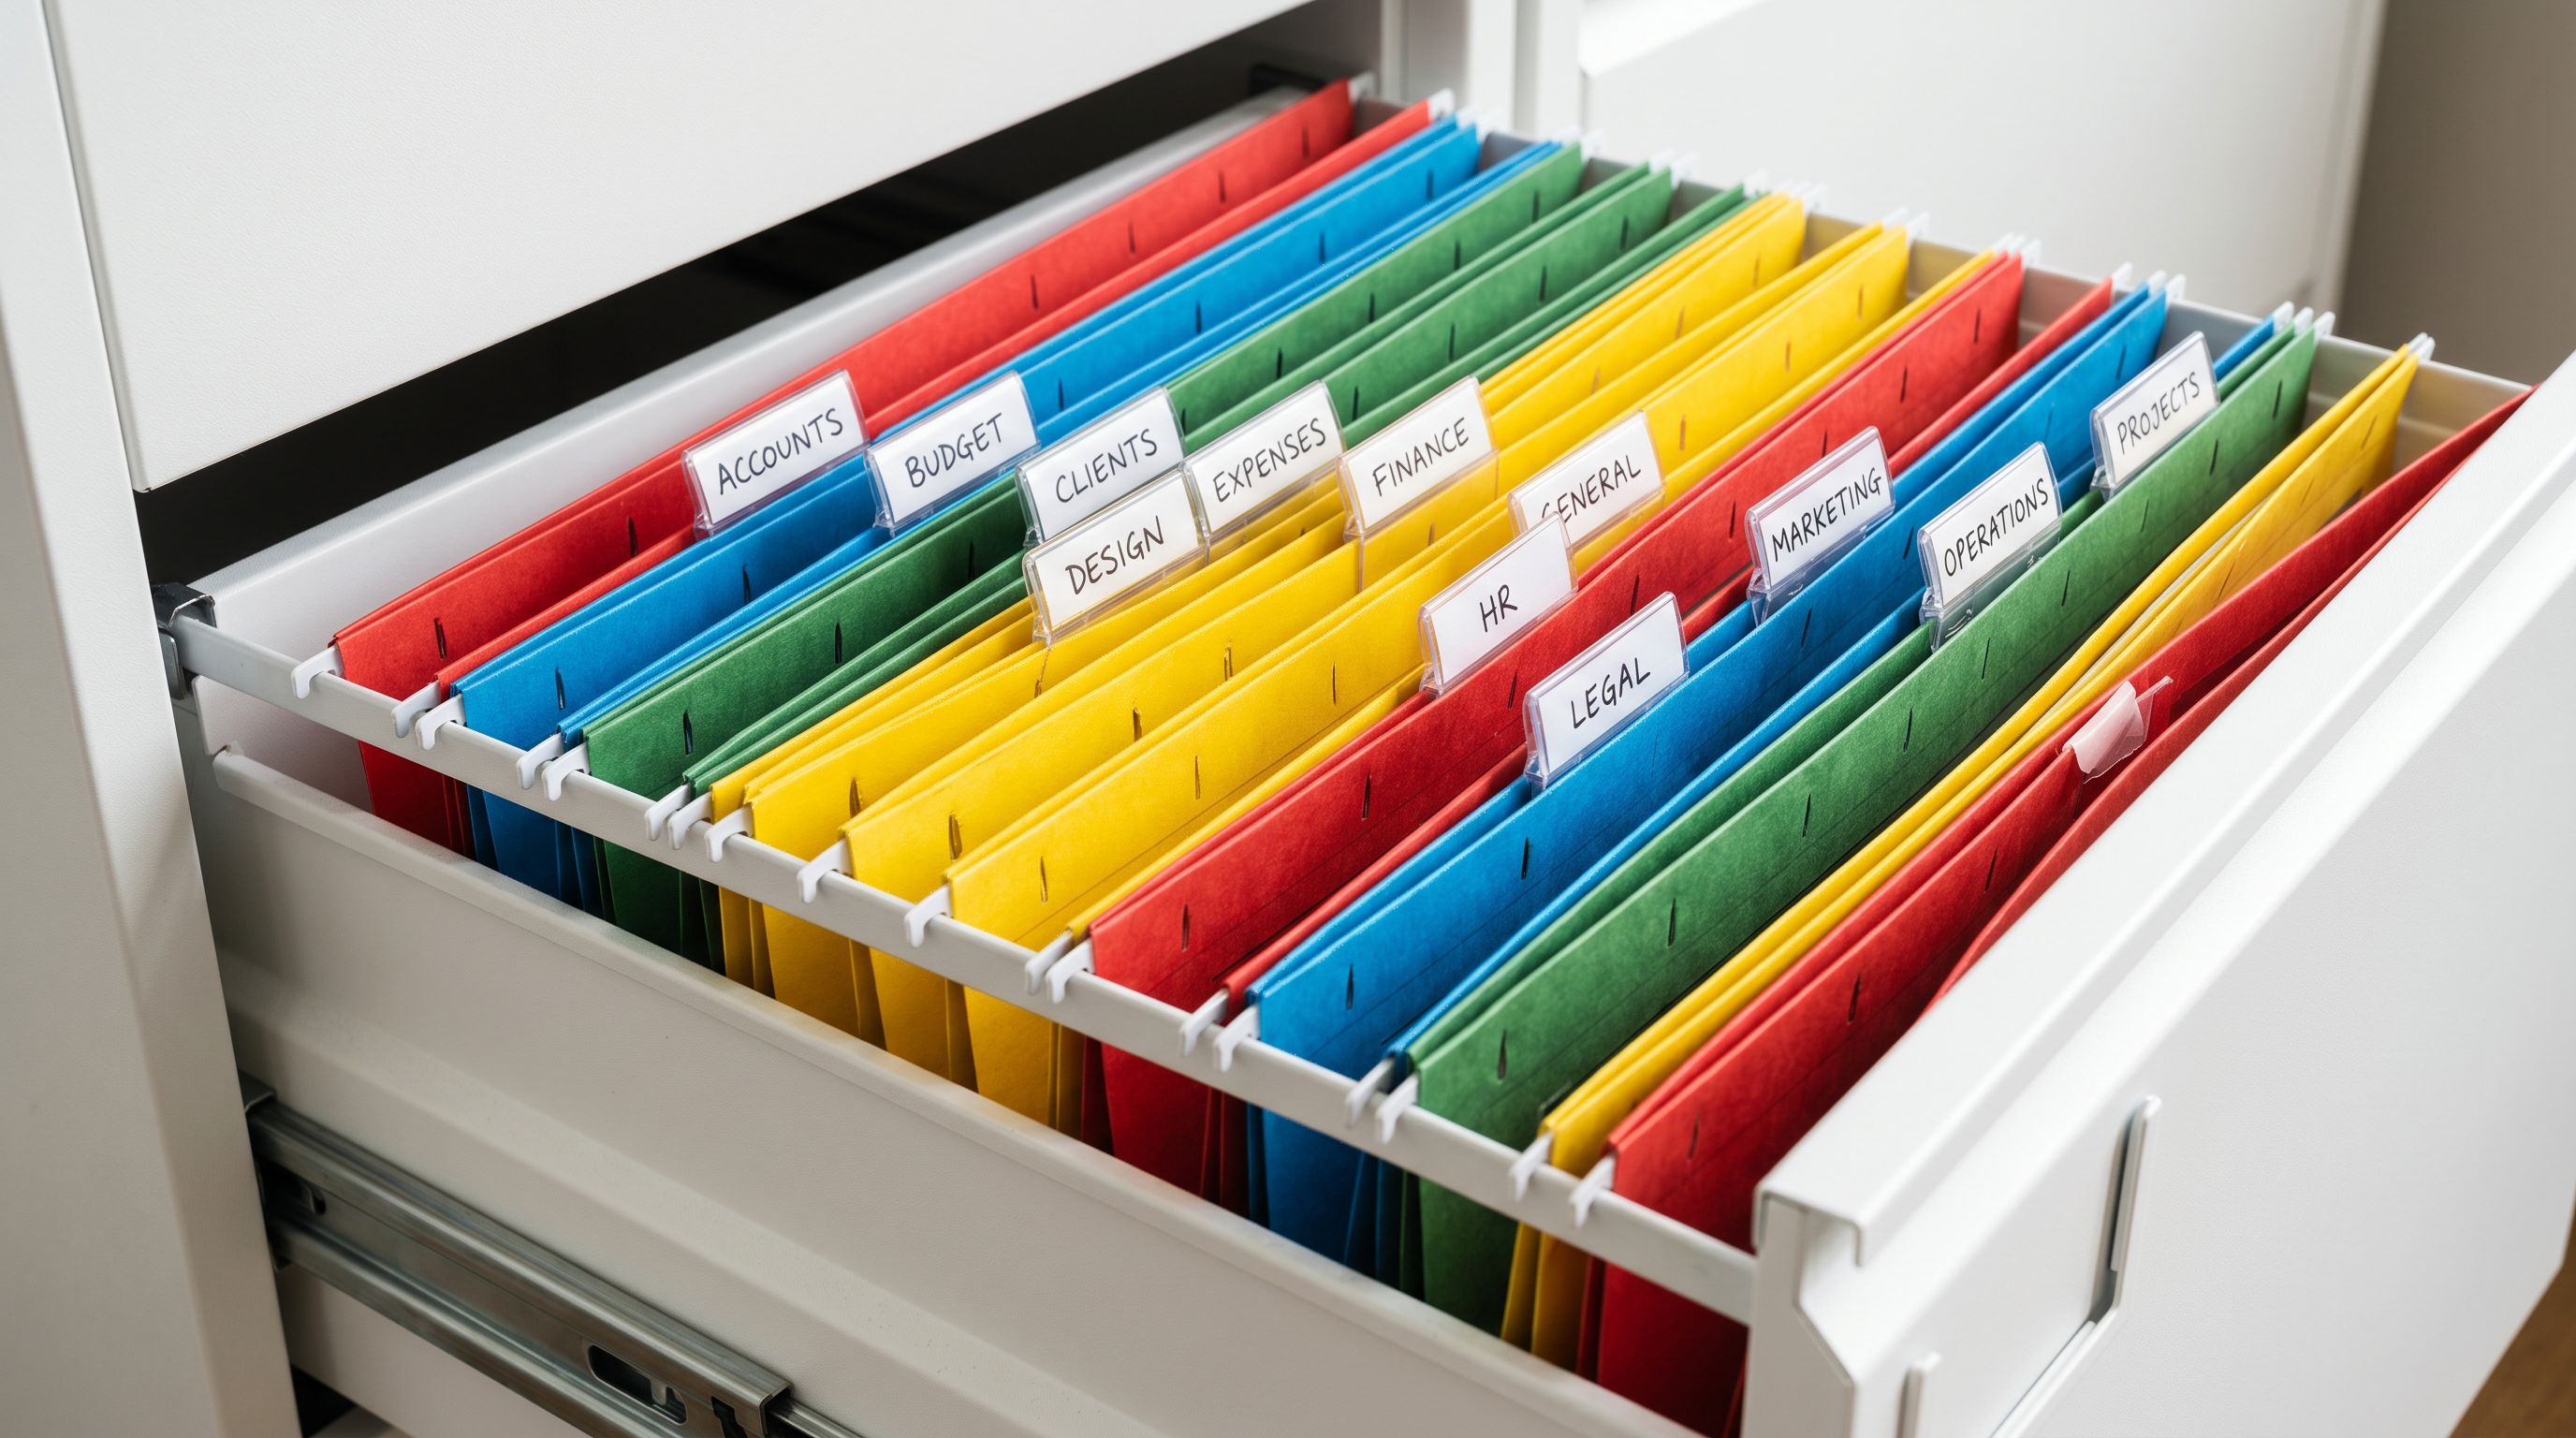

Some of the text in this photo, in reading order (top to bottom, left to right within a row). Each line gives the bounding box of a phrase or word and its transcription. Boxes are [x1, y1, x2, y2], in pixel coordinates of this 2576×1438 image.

[717, 408, 843, 495] ACCOUNTS
[906, 412, 1003, 488] BUDGET
[2116, 371, 2200, 455] PROJECTS
[1056, 428, 1158, 504] CLIENTS
[1213, 418, 1326, 503] EXPENSES
[1372, 418, 1470, 497] FINANCE
[1772, 467, 1881, 563] MARKETING
[1943, 478, 2049, 578] OPERATIONS
[1064, 516, 1164, 595] DESIGN
[1479, 584, 1519, 633] HR
[1571, 657, 1651, 729] LEGAL
